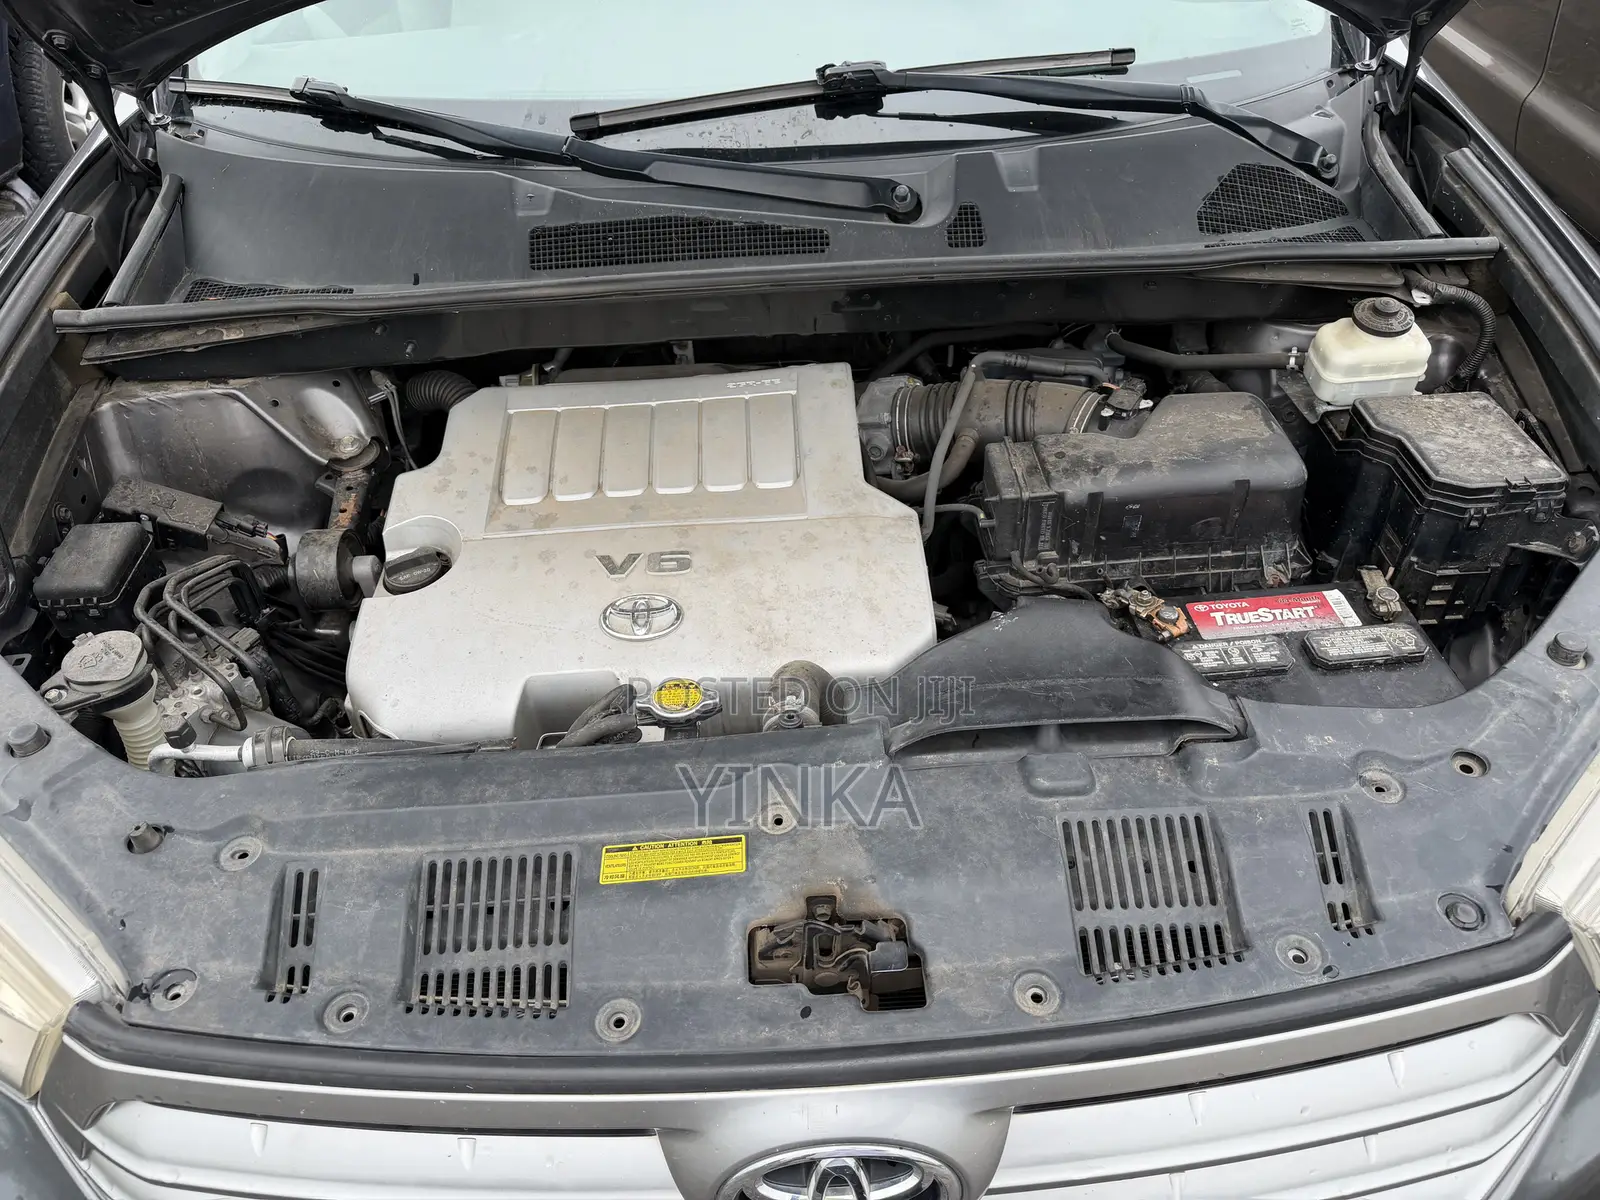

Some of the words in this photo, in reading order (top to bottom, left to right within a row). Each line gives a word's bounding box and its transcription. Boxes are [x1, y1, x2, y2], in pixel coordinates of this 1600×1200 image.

[595, 549, 693, 581] V6
[1209, 601, 1250, 610] TOYOTA
[639, 842, 665, 850] CAUTION
[668, 840, 698, 849] ATTENTION
